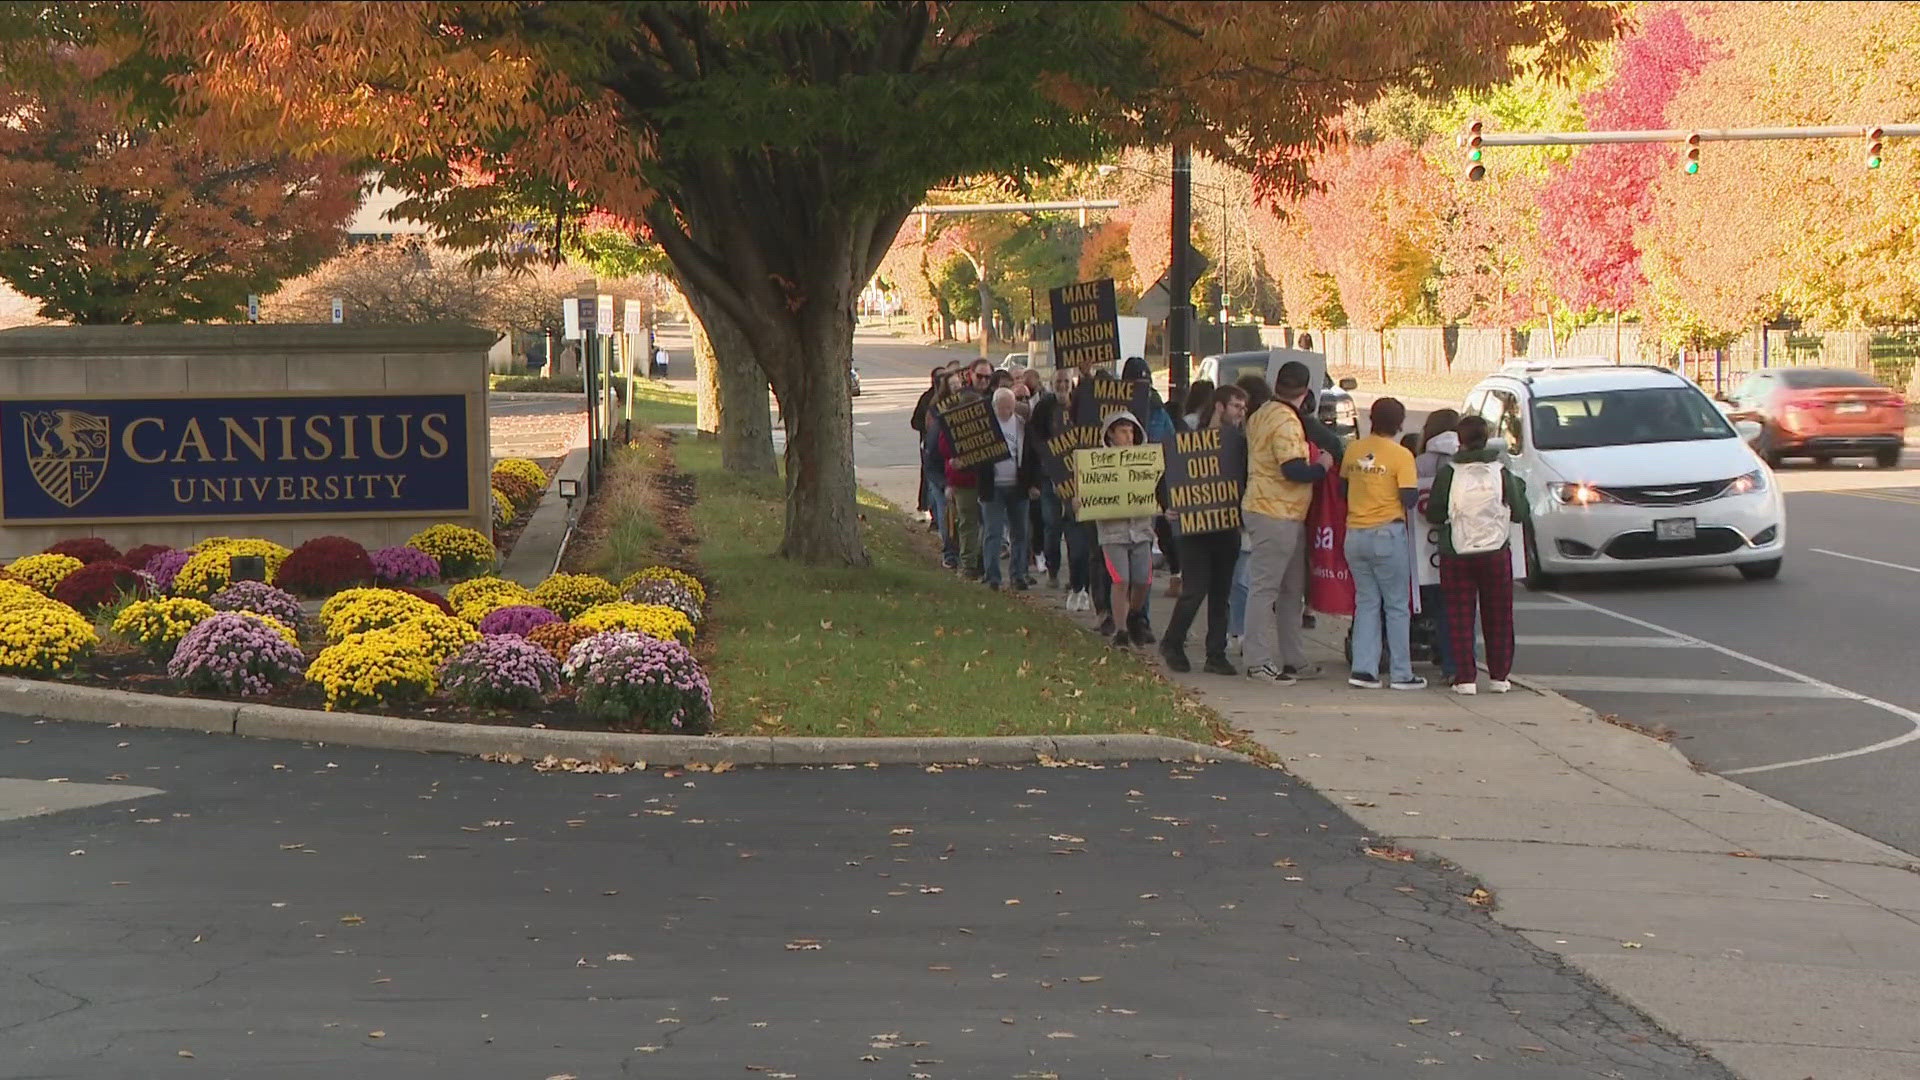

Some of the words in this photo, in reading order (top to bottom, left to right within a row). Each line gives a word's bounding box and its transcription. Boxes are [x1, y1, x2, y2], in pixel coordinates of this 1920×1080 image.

[1062, 282, 1100, 304] MAKE
[1071, 304, 1098, 323] OUR
[1055, 322, 1114, 347] MISSION
[1063, 344, 1113, 367] MATTER
[1094, 380, 1133, 400] MAKE
[944, 403, 987, 427] PROTECT
[121, 413, 449, 464] CANISIUS
[950, 416, 990, 440] FACULTY
[955, 431, 995, 453] PROTECT
[1176, 429, 1221, 454] MAKE
[957, 441, 1009, 468] DUCATION
[1188, 456, 1220, 478] OUR
[172, 475, 406, 503] UNIVERSITY
[1170, 480, 1238, 508] MISSION
[1181, 507, 1240, 533] MATTER
